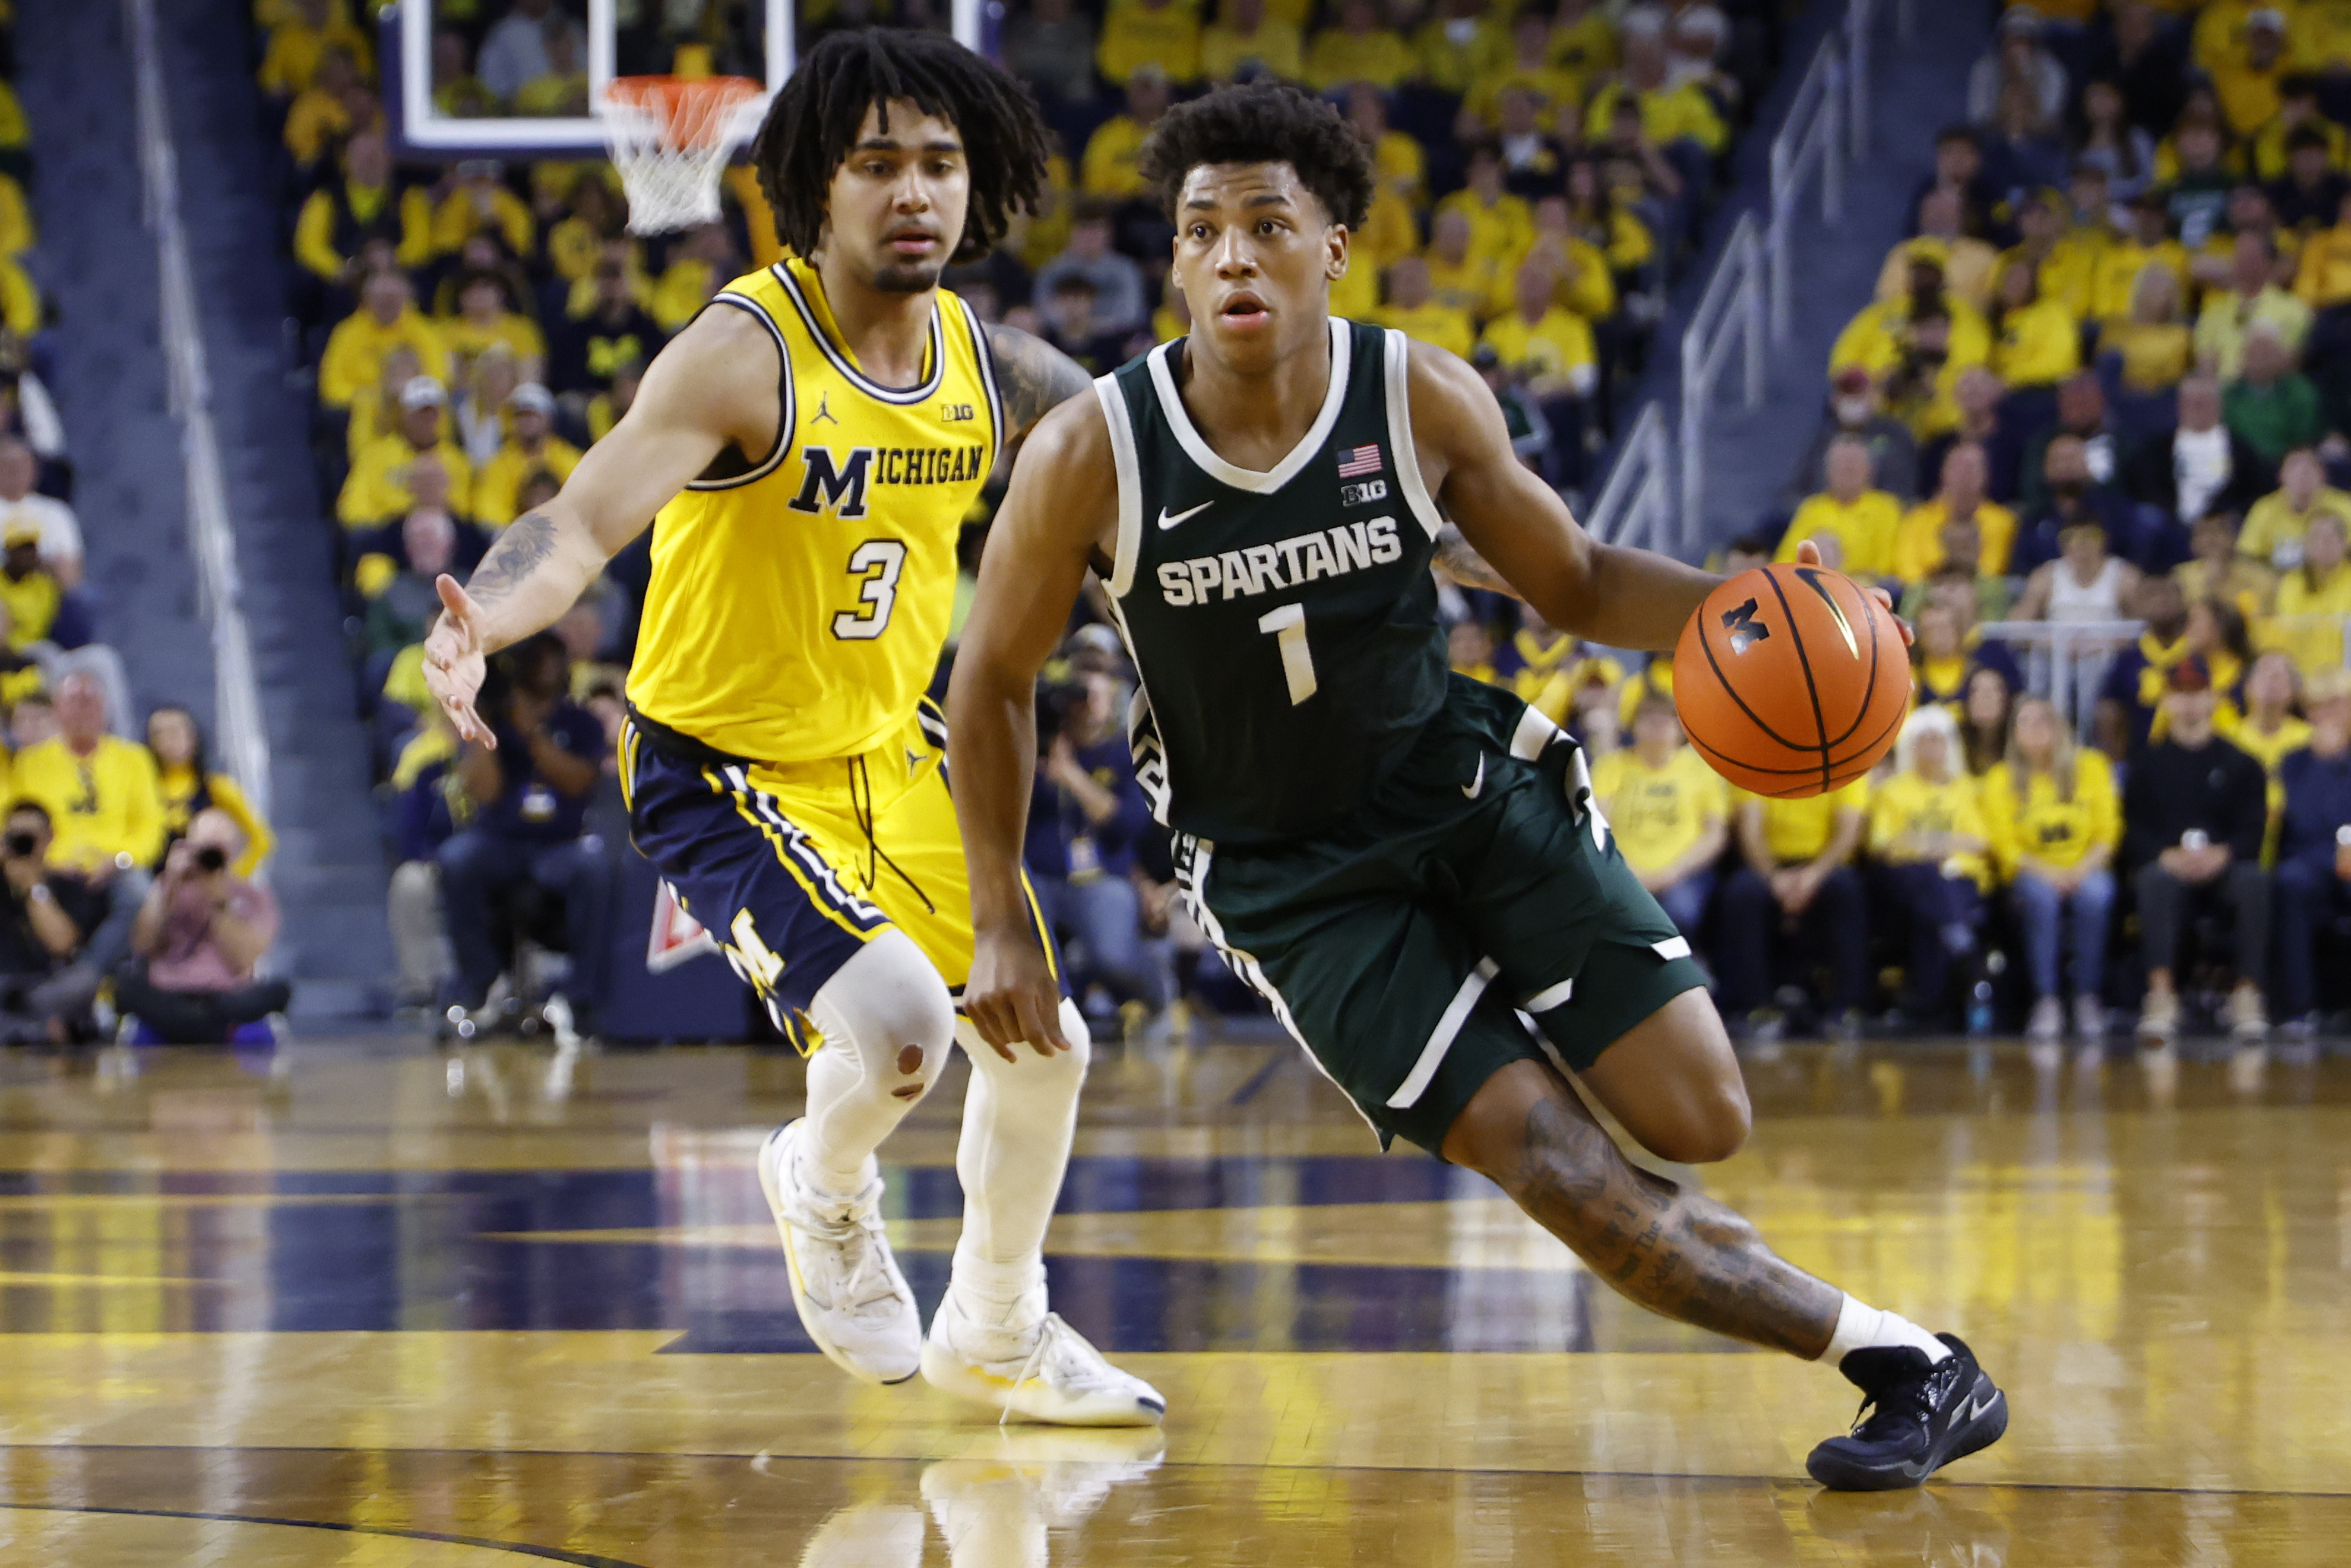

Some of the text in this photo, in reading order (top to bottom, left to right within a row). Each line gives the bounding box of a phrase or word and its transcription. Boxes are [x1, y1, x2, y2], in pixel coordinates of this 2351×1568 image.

[787, 445, 983, 520] MICHIGAN
[831, 538, 907, 641] 3
[1156, 515, 1402, 607] SPARTANS
[1258, 603, 1318, 706] 1
[1721, 597, 1770, 656] M
